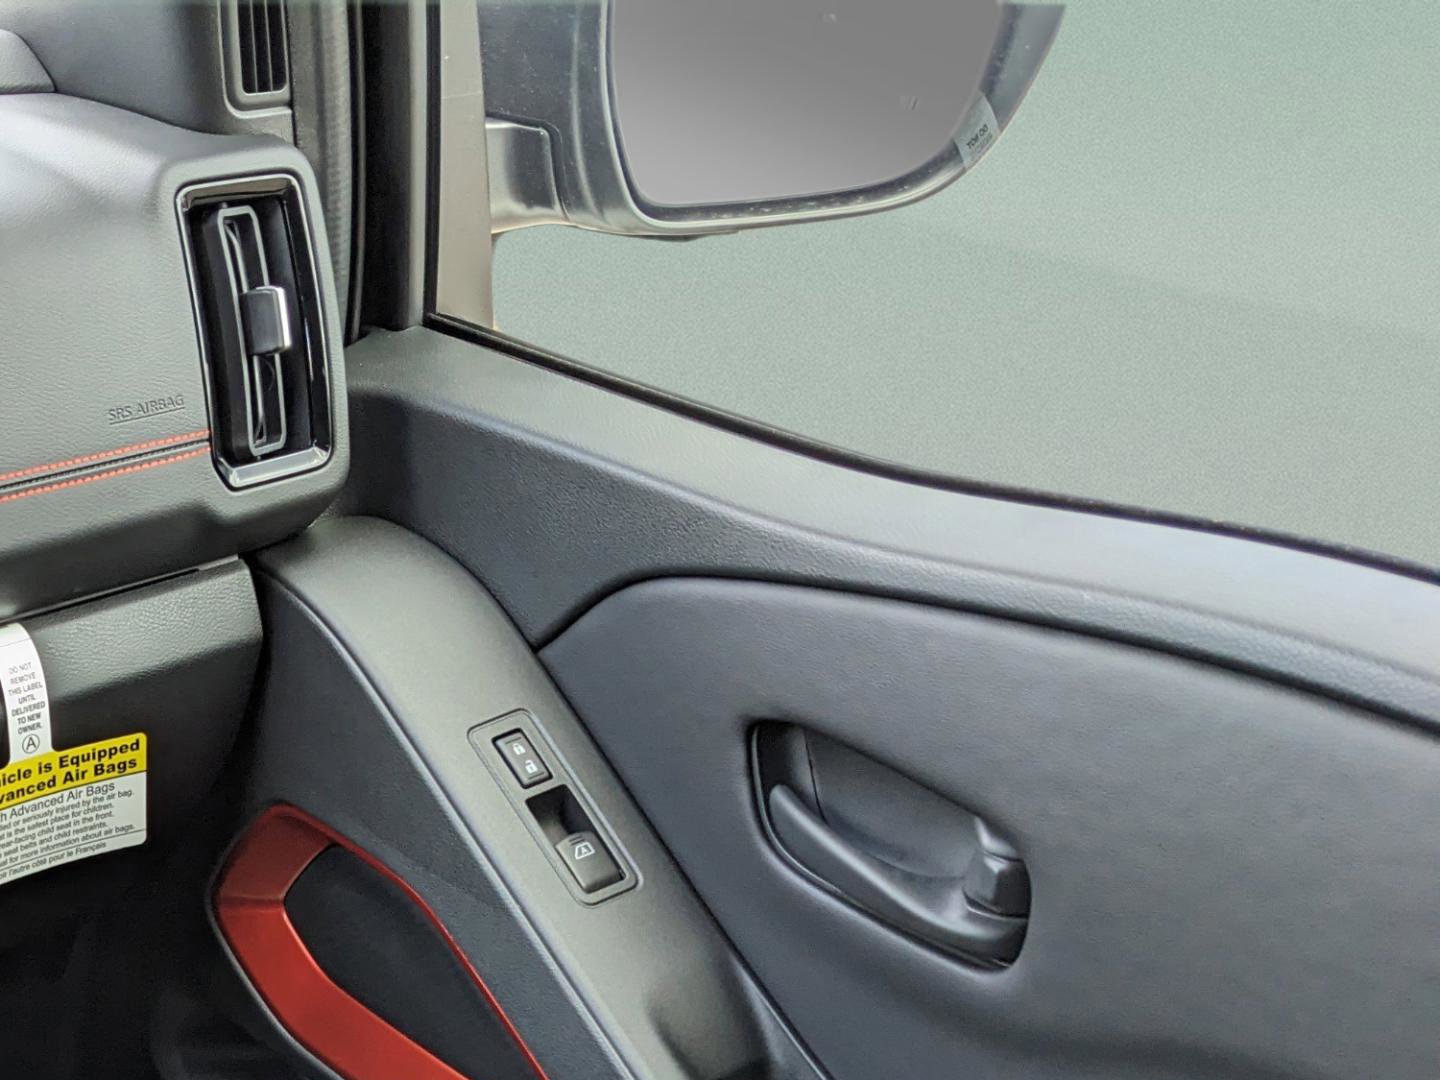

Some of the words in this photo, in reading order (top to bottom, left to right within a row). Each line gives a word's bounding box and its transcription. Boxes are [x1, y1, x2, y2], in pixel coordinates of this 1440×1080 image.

[108, 406, 132, 421] SRS
[136, 395, 185, 414] AIRBAG
[23, 681, 43, 693] LABEL
[11, 701, 46, 717] DELIVERED
[17, 716, 26, 725] TO
[27, 712, 41, 722] NEW
[38, 761, 53, 775] is
[59, 739, 140, 769] Equipped
[63, 769, 88, 785] Air
[94, 757, 137, 776] Bags
[10, 793, 64, 819] Advanced
[66, 789, 83, 801] Air
[86, 782, 115, 796] Bags
[22, 809, 54, 824] seriously
[55, 801, 80, 814] injured
[82, 799, 91, 808] by
[92, 794, 105, 804] the
[106, 792, 116, 802] air
[117, 788, 134, 799] bag.
[0, 832, 36, 850] rear-facing
[37, 826, 54, 838] child
[56, 820, 71, 831] seat
[81, 815, 94, 825] the
[14, 826, 26, 836] the
[27, 818, 48, 831] safest
[50, 813, 70, 825] place
[71, 808, 81, 818] for
[3, 846, 19, 857] seat
[20, 840, 37, 852] belts
[38, 834, 53, 845] and
[54, 829, 71, 841] child
[9, 855, 19, 864] for
[20, 849, 39, 861] more
[40, 836, 80, 853] information
[81, 829, 102, 841] about
[103, 826, 113, 836] air
[48, 851, 65, 864] pour
[75, 842, 106, 856] Français
